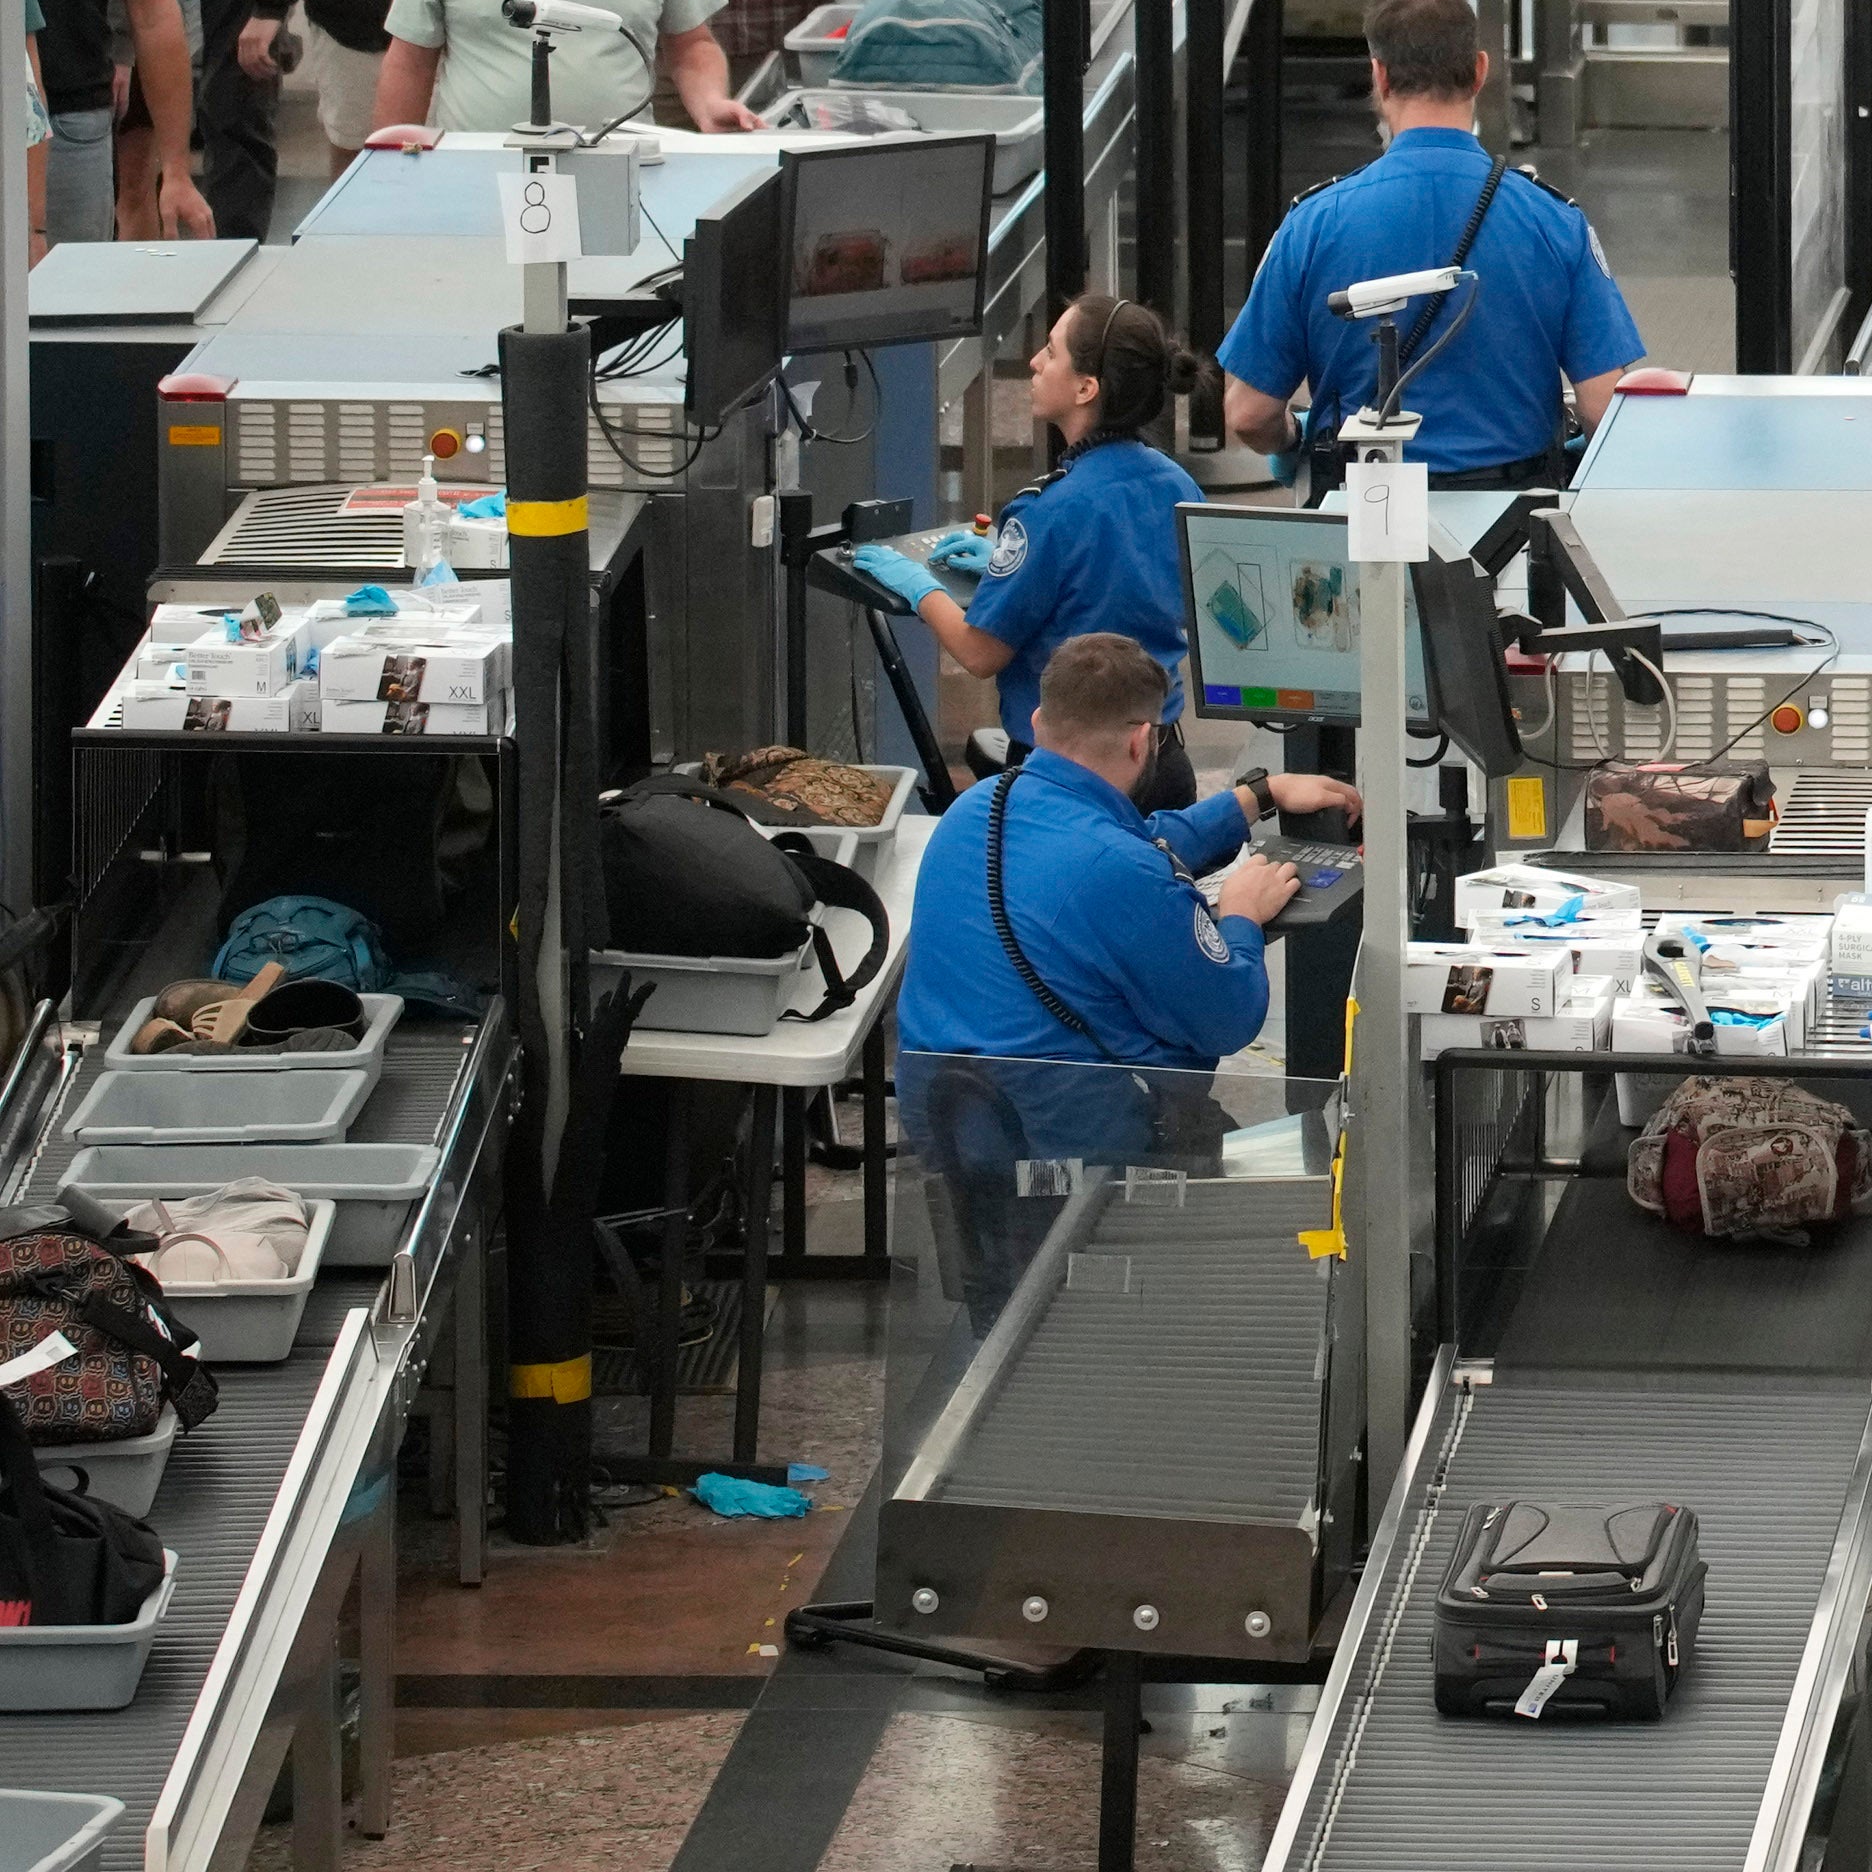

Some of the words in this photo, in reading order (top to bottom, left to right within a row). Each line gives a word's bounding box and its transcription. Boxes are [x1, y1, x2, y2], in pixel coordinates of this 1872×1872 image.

[520, 181, 551, 234] 8
[1363, 484, 1390, 536] 9
[256, 680, 267, 693] M
[448, 685, 477, 700] XXL
[303, 711, 320, 725] XL
[1838, 952, 1863, 960] MASK
[1531, 997, 1541, 1011] S
